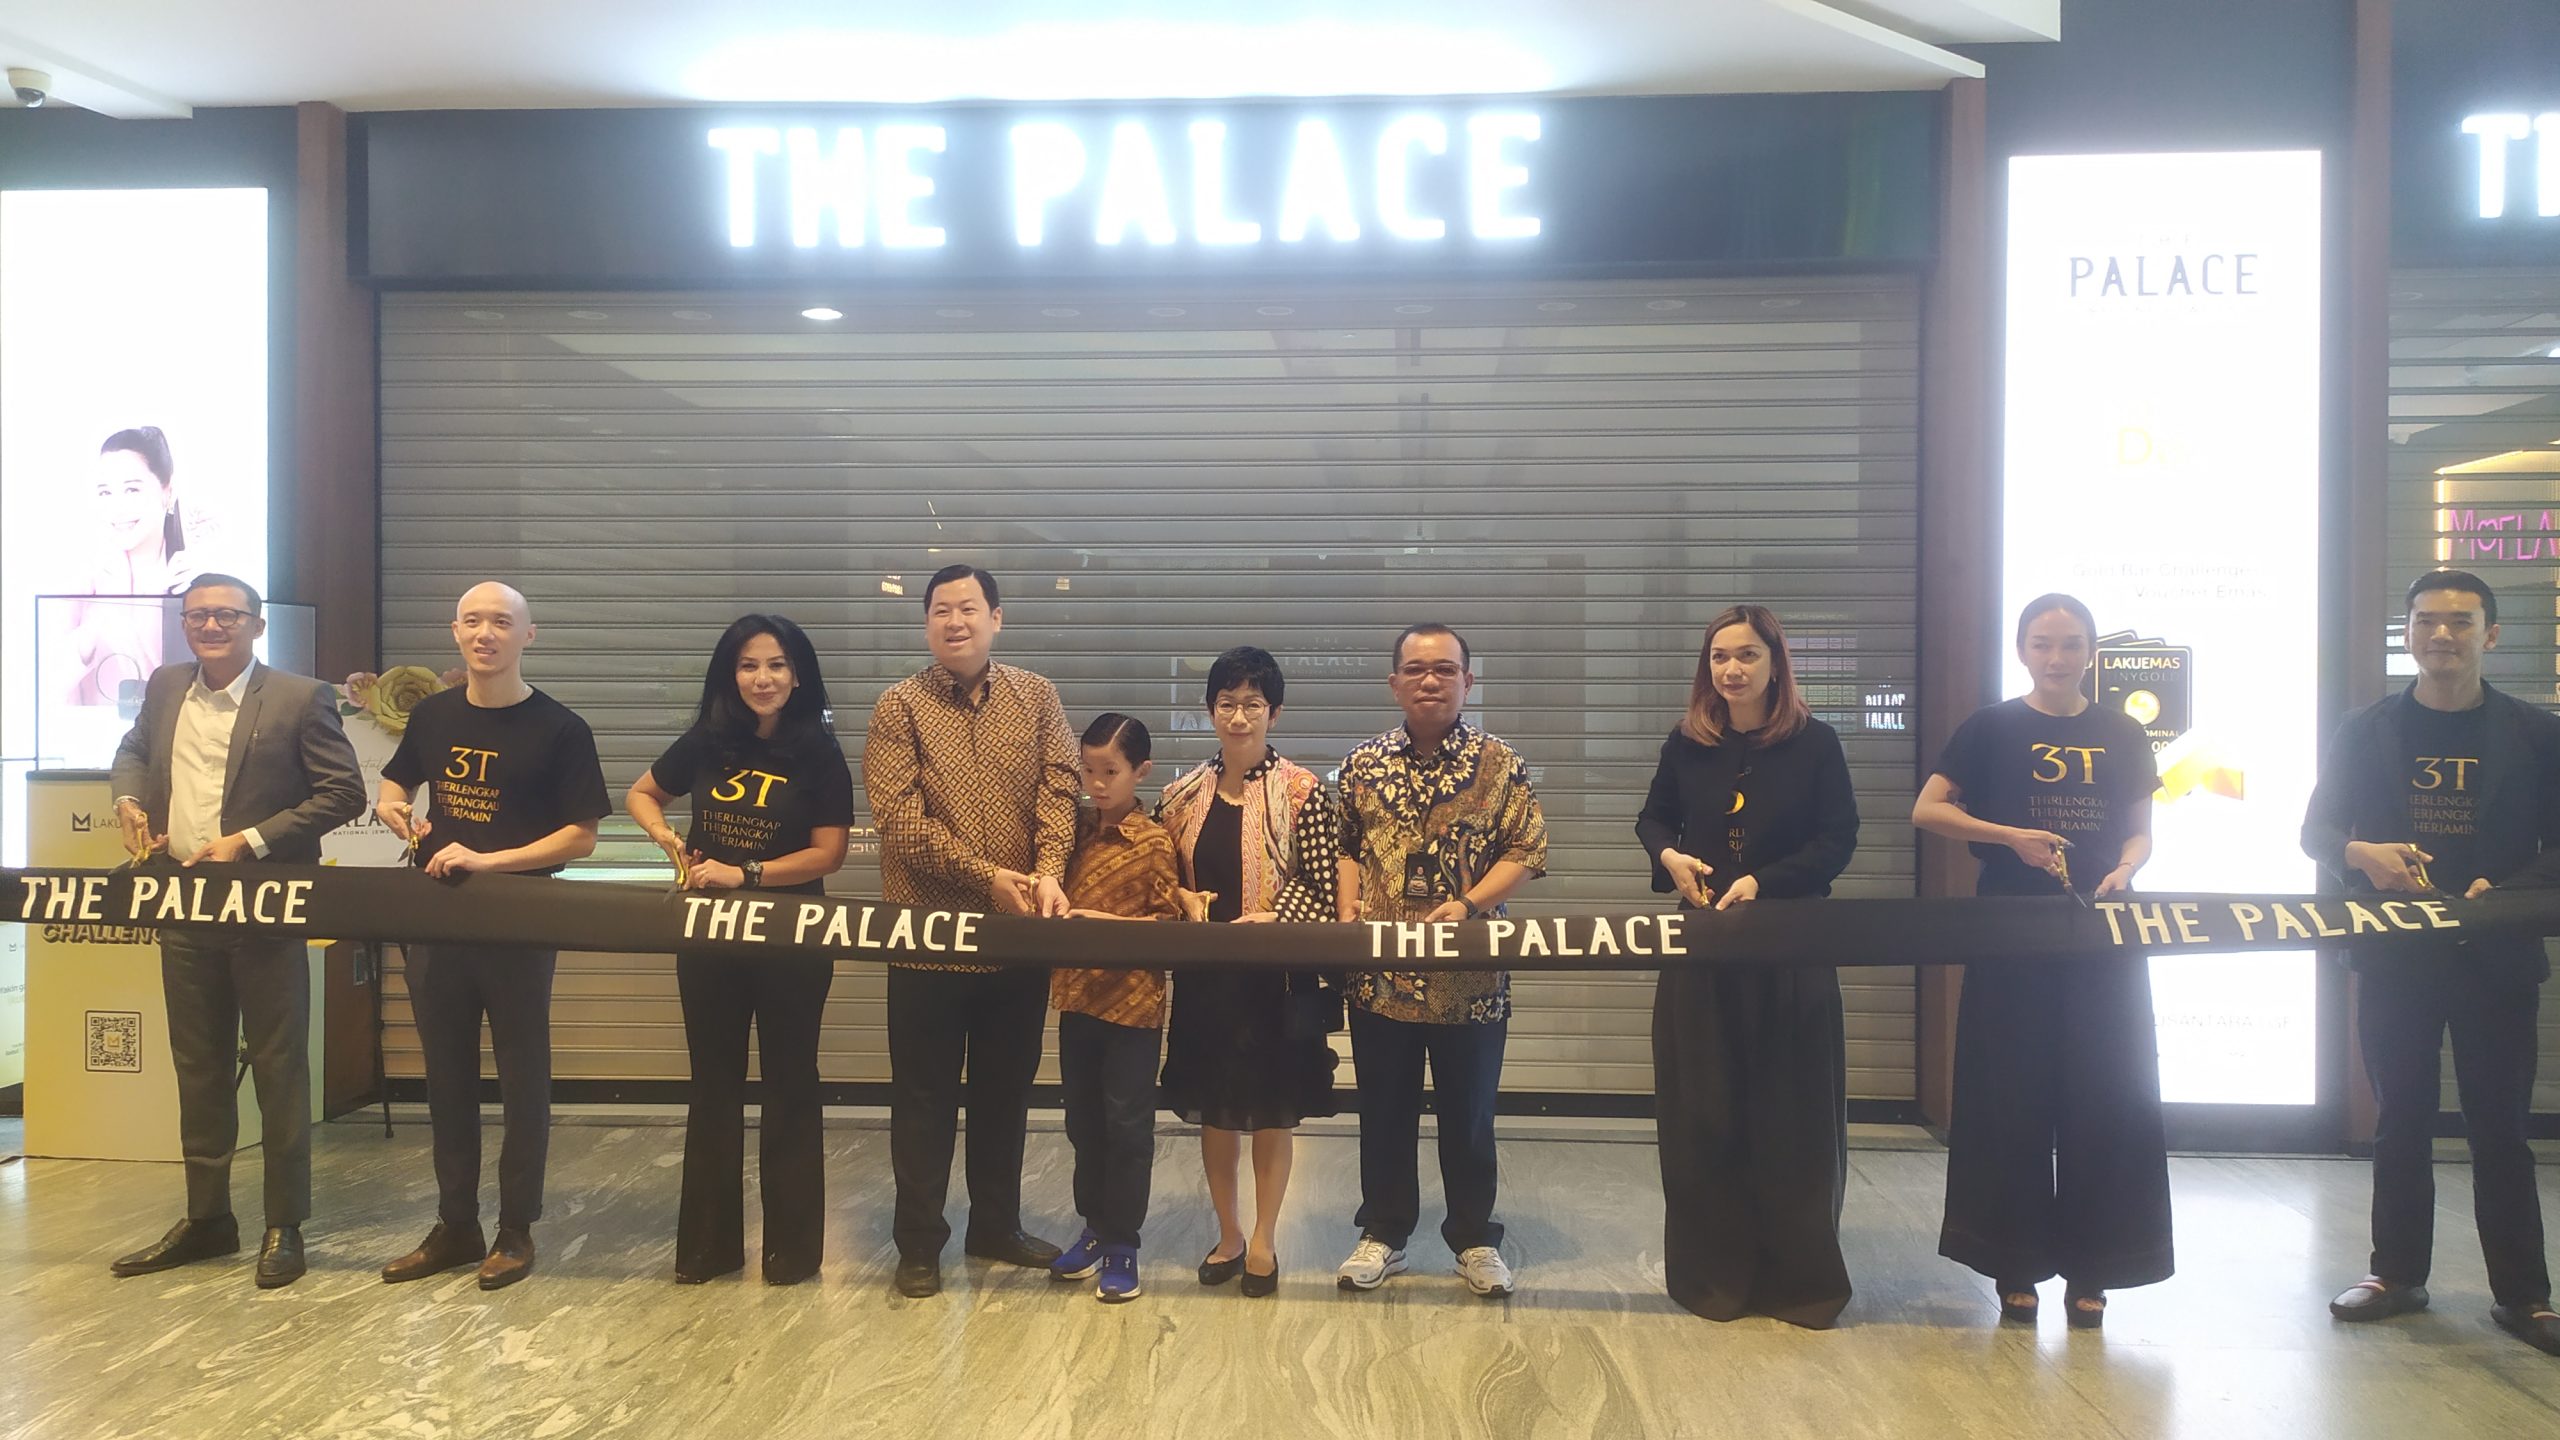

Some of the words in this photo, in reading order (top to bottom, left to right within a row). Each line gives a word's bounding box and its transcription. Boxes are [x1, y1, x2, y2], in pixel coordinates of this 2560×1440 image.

[708, 119, 946, 249] THE
[1007, 108, 1541, 247] PALACE
[2069, 254, 2259, 298] PALACE
[2104, 656, 2180, 670] LAKUEMAS
[444, 746, 500, 783] 3T
[2031, 743, 2106, 785] 3T
[2411, 757, 2479, 791] 3T
[711, 766, 788, 808] 3T
[20, 877, 109, 920] THE
[129, 878, 314, 925] PALACE
[683, 897, 775, 943] THE
[795, 904, 985, 952] PALACE
[1365, 920, 1460, 958] THE
[1487, 915, 1687, 957] PALACE
[2095, 901, 2211, 946] THE
[2229, 900, 2461, 941] PALACE
